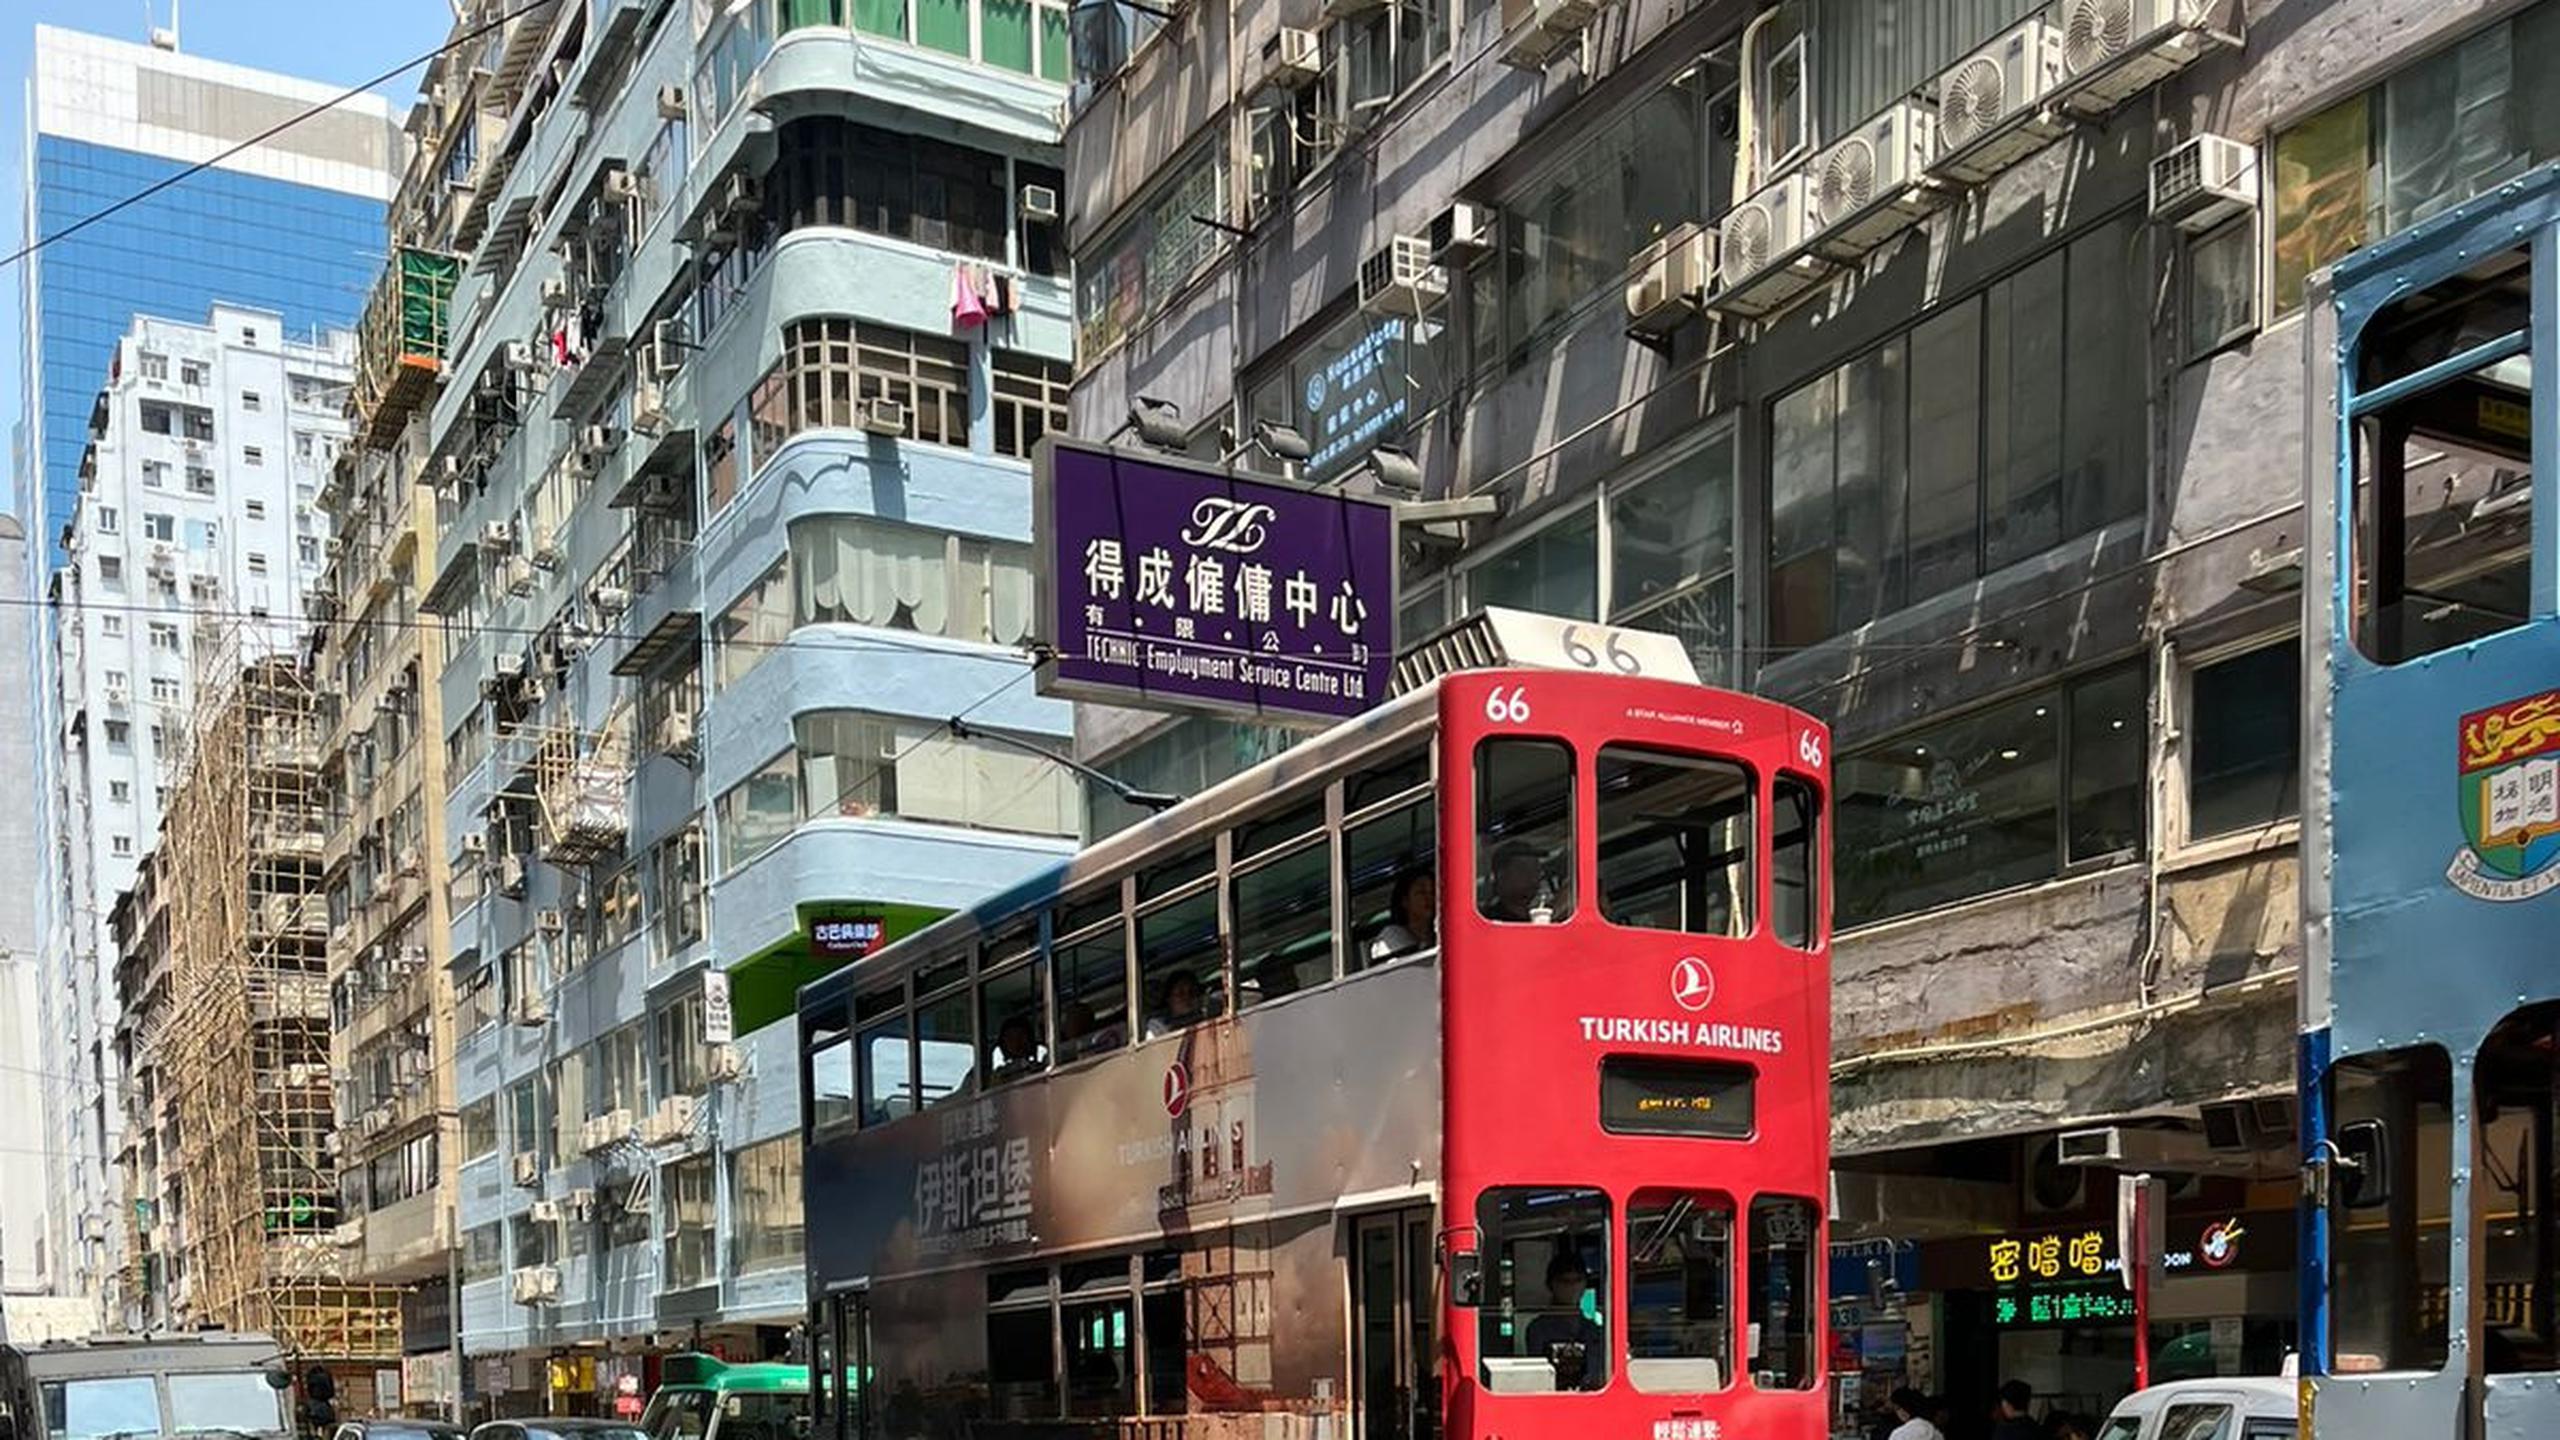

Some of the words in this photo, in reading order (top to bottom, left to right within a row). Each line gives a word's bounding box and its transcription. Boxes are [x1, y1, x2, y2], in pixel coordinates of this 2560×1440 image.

[1083, 538, 1368, 635] 得成僱傭中心
[1146, 643, 1234, 681] Employment
[1239, 656, 1291, 689] Service
[1295, 665, 1339, 695] Centre
[1562, 625, 1641, 675] 66
[1485, 686, 1531, 723] 66
[1634, 708, 1656, 719] STAR
[1657, 711, 1695, 724] ALLIANCE
[1800, 729, 1822, 768] 66
[1579, 1016, 1690, 1045] TURKISH
[1695, 1023, 1782, 1053] AIRLINES
[913, 1137, 1034, 1238] 伊斯坦堡
[1989, 1231, 2104, 1282] 密噹噹
